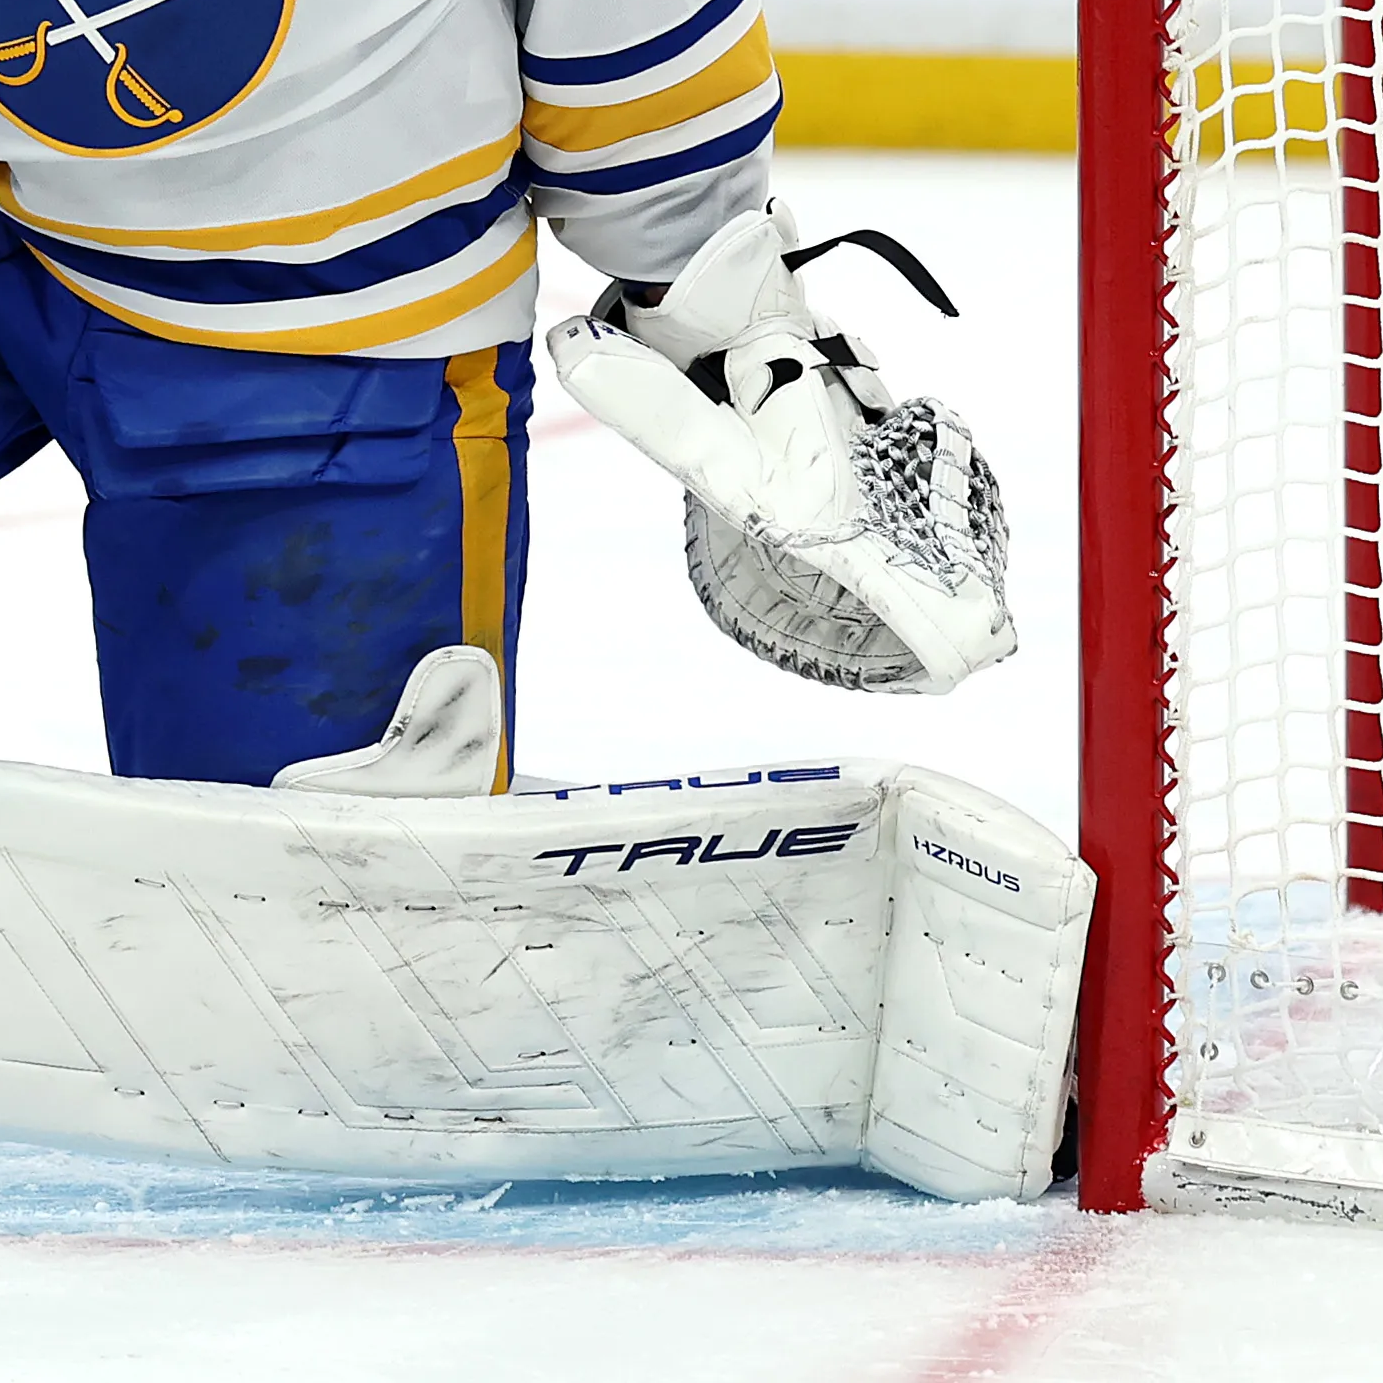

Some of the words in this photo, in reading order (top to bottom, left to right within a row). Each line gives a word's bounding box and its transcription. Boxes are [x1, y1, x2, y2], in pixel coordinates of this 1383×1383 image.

[513, 765, 840, 800] TRUE
[533, 823, 859, 878] TRUE
[913, 834, 1020, 892] HZRDUS
